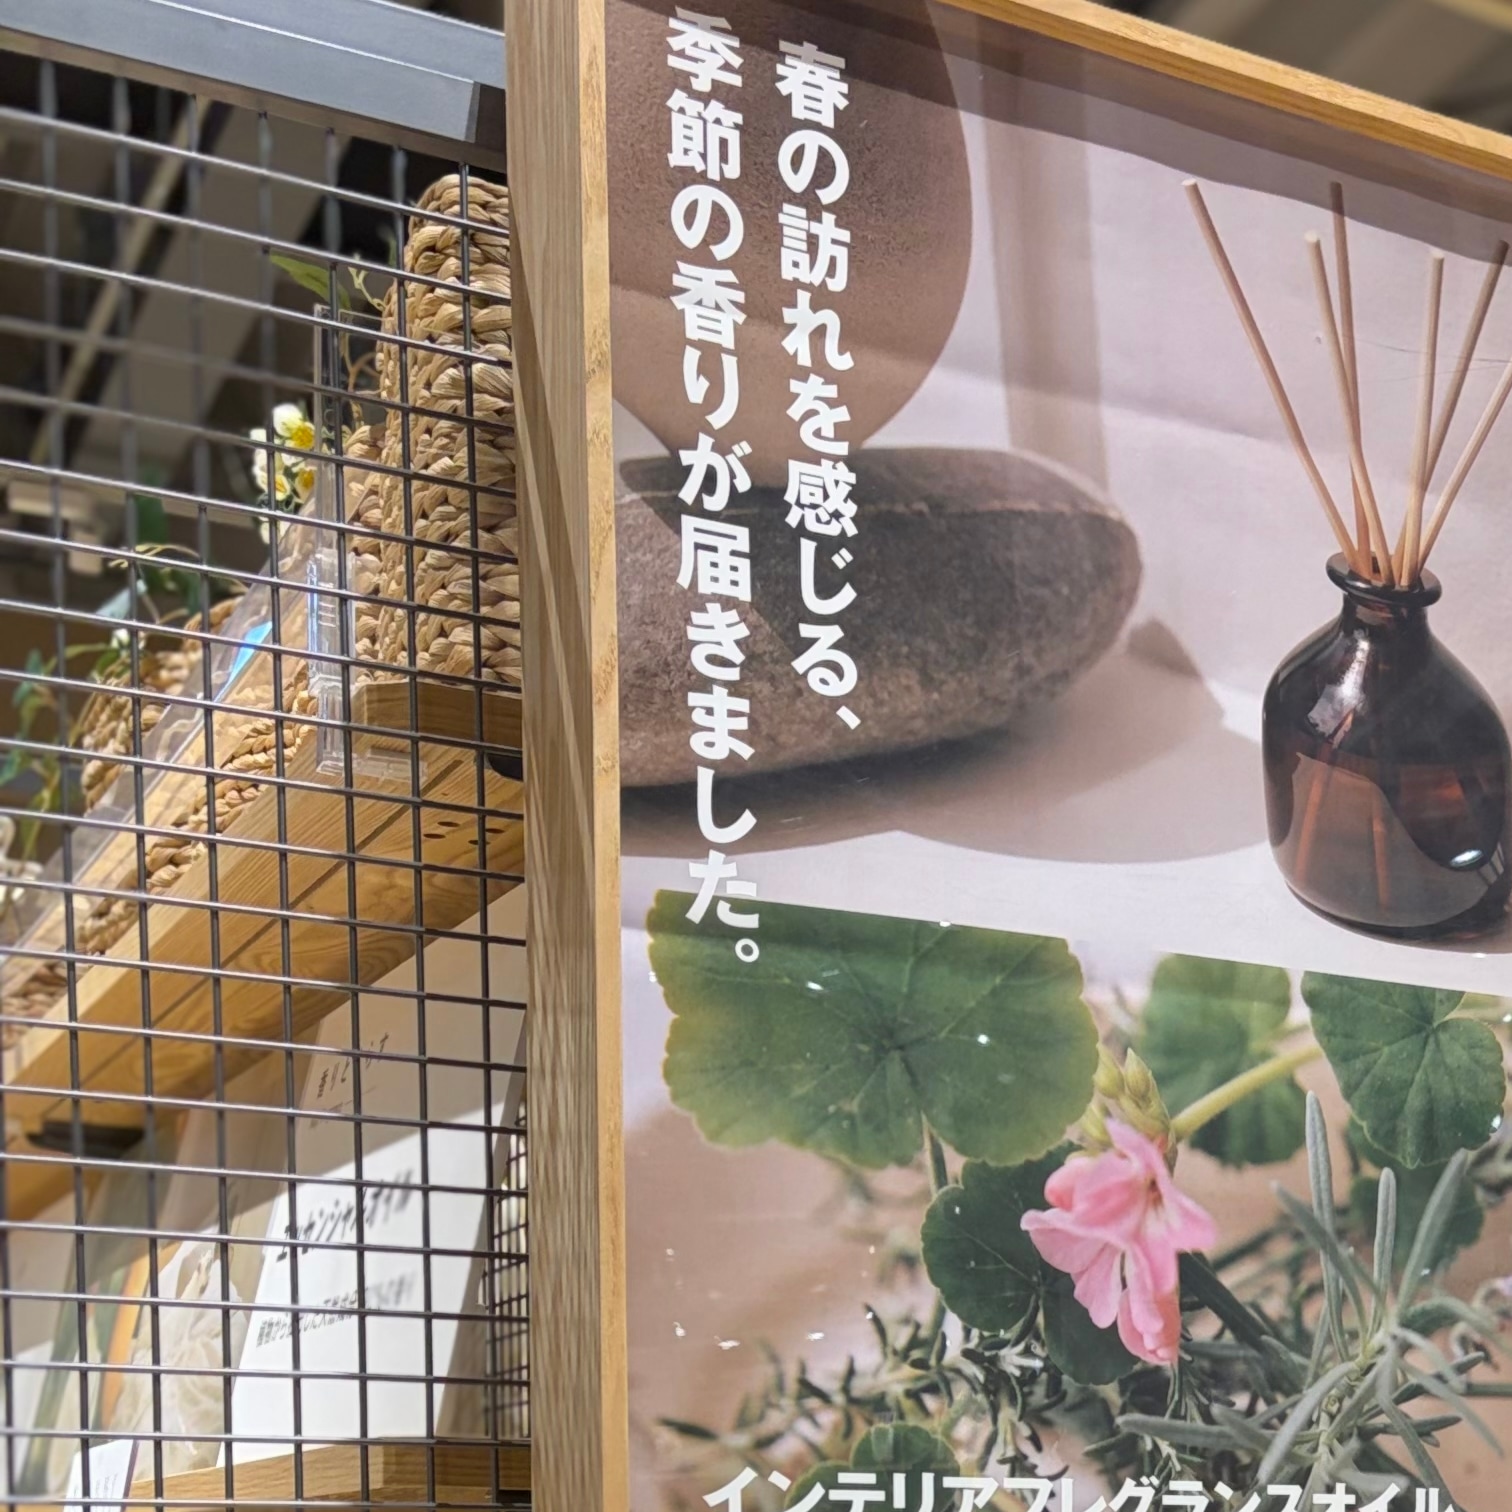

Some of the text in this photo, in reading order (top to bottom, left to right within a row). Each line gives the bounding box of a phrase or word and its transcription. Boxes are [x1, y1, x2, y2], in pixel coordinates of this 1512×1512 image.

[666, 6, 760, 964] 季節の香りが届きました。
[776, 40, 861, 732] 春の訪れを感じる、
